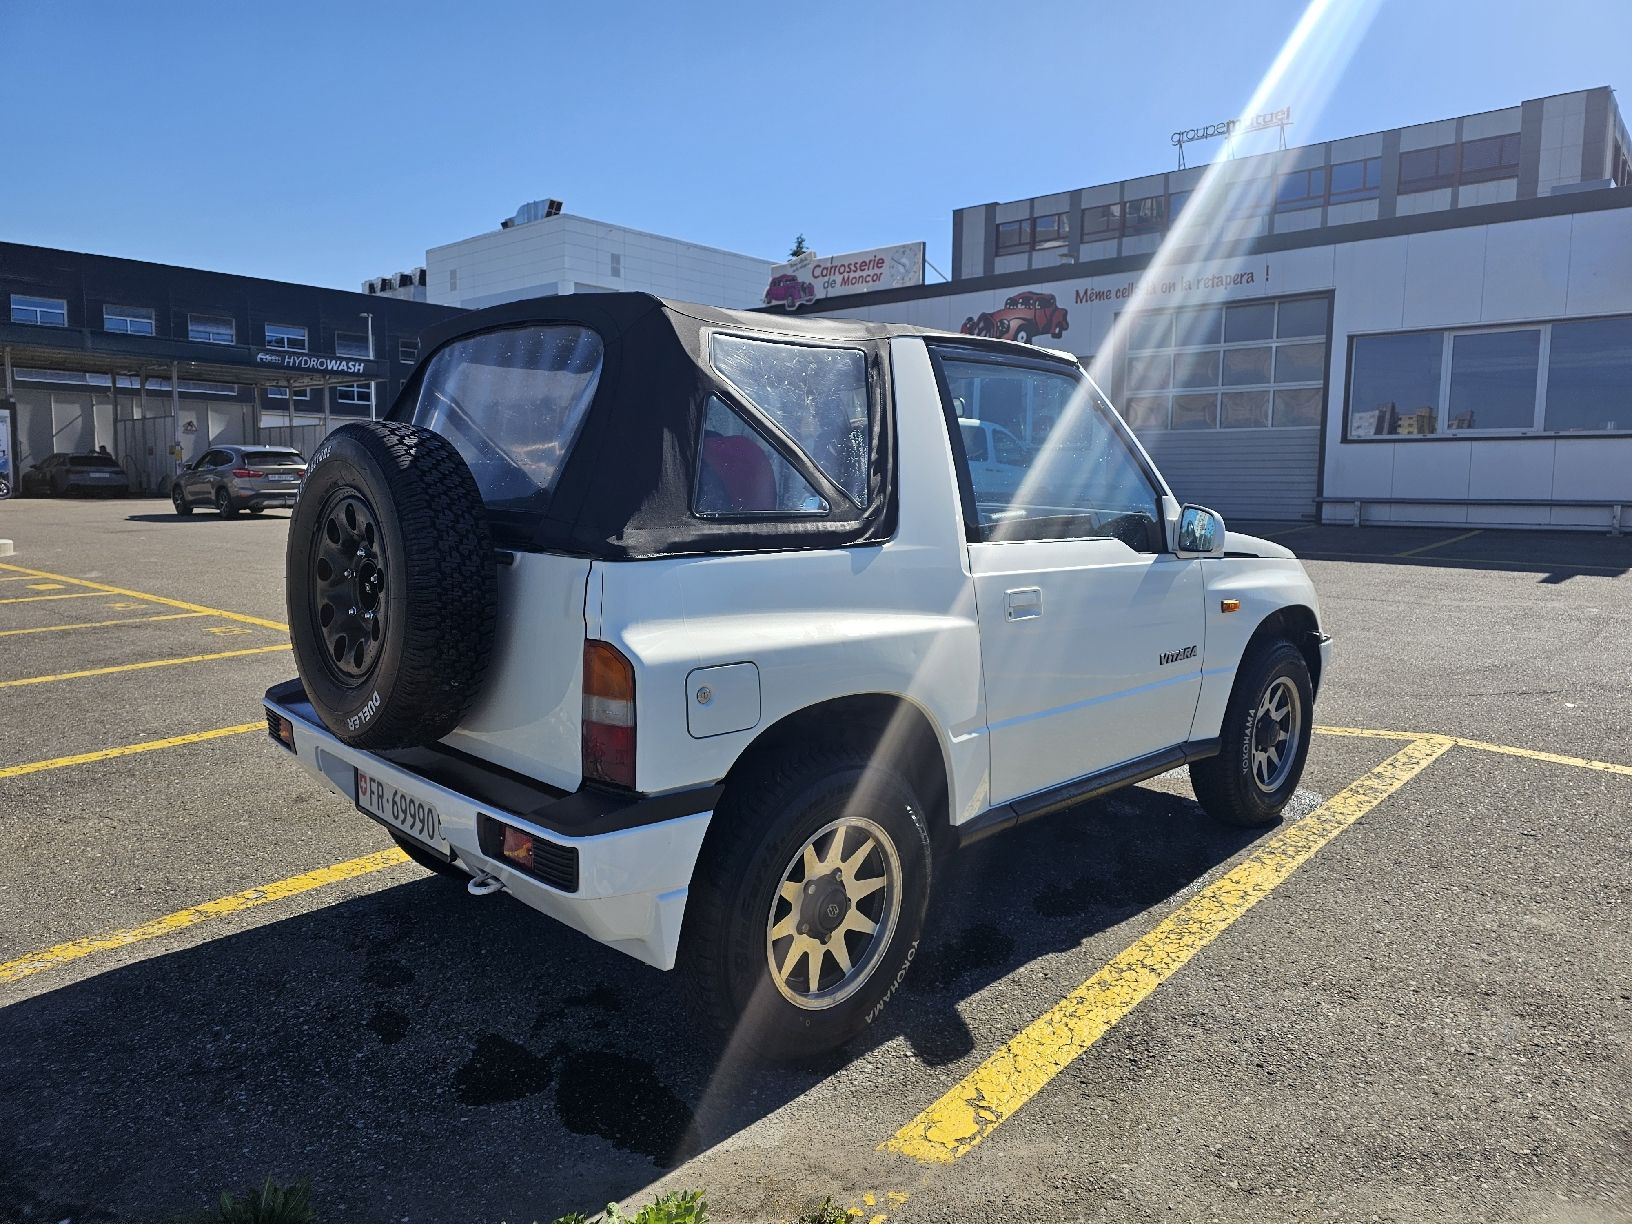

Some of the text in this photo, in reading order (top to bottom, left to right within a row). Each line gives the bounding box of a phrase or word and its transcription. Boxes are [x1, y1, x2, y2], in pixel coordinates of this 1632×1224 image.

[812, 254, 885, 280] Carrosserie
[823, 271, 883, 290] de Moncor
[1075, 286, 1112, 304] Même
[1161, 281, 1176, 294] on
[1196, 271, 1254, 291] retapera
[284, 355, 364, 373] HYDROWASH
[1159, 645, 1197, 666] VITARA
[347, 690, 381, 731] DUELER
[1242, 709, 1256, 775] YOKOHAMA
[865, 939, 920, 1024] YOKOHAMA
